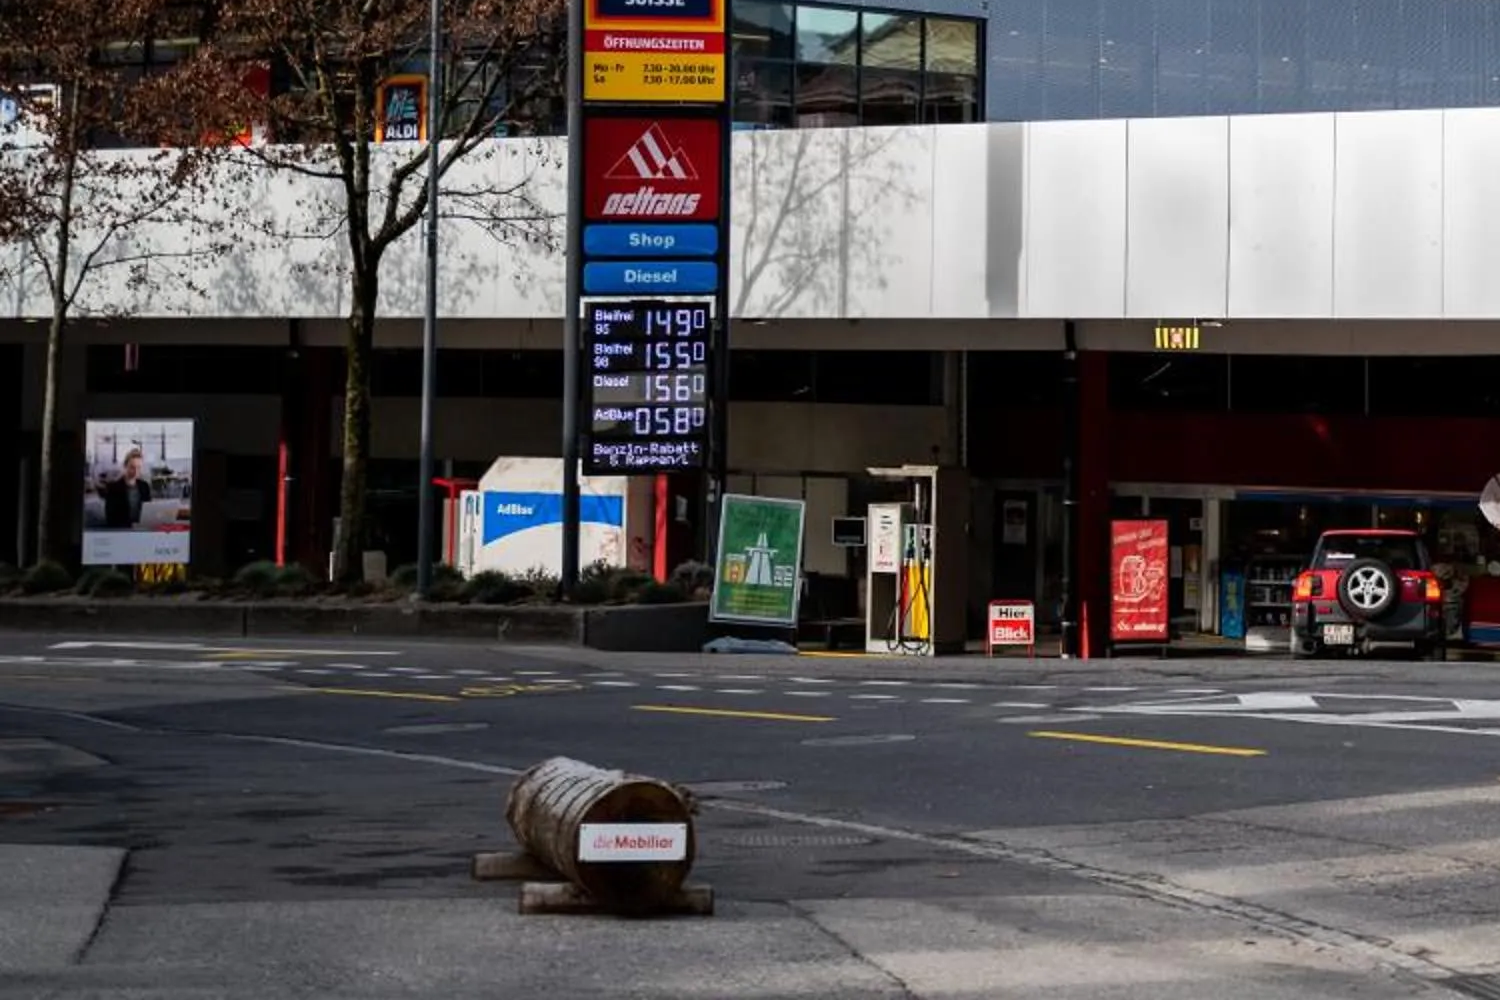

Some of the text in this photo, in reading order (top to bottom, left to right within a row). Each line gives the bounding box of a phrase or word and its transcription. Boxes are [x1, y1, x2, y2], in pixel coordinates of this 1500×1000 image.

[603, 34, 705, 50] ÖFFNUNGSZEITEN
[385, 124, 418, 139] ALDI
[602, 186, 702, 216] oeltrans
[629, 232, 675, 249] Shop
[624, 269, 678, 284] Diesel
[595, 309, 634, 322] Bleifrei
[594, 343, 633, 355] Bleifrei
[593, 375, 629, 387] Diesel
[593, 408, 635, 421] AdBlue
[497, 503, 534, 516] AdBlue
[999, 607, 1025, 619] Hier
[994, 626, 1029, 640] Blick
